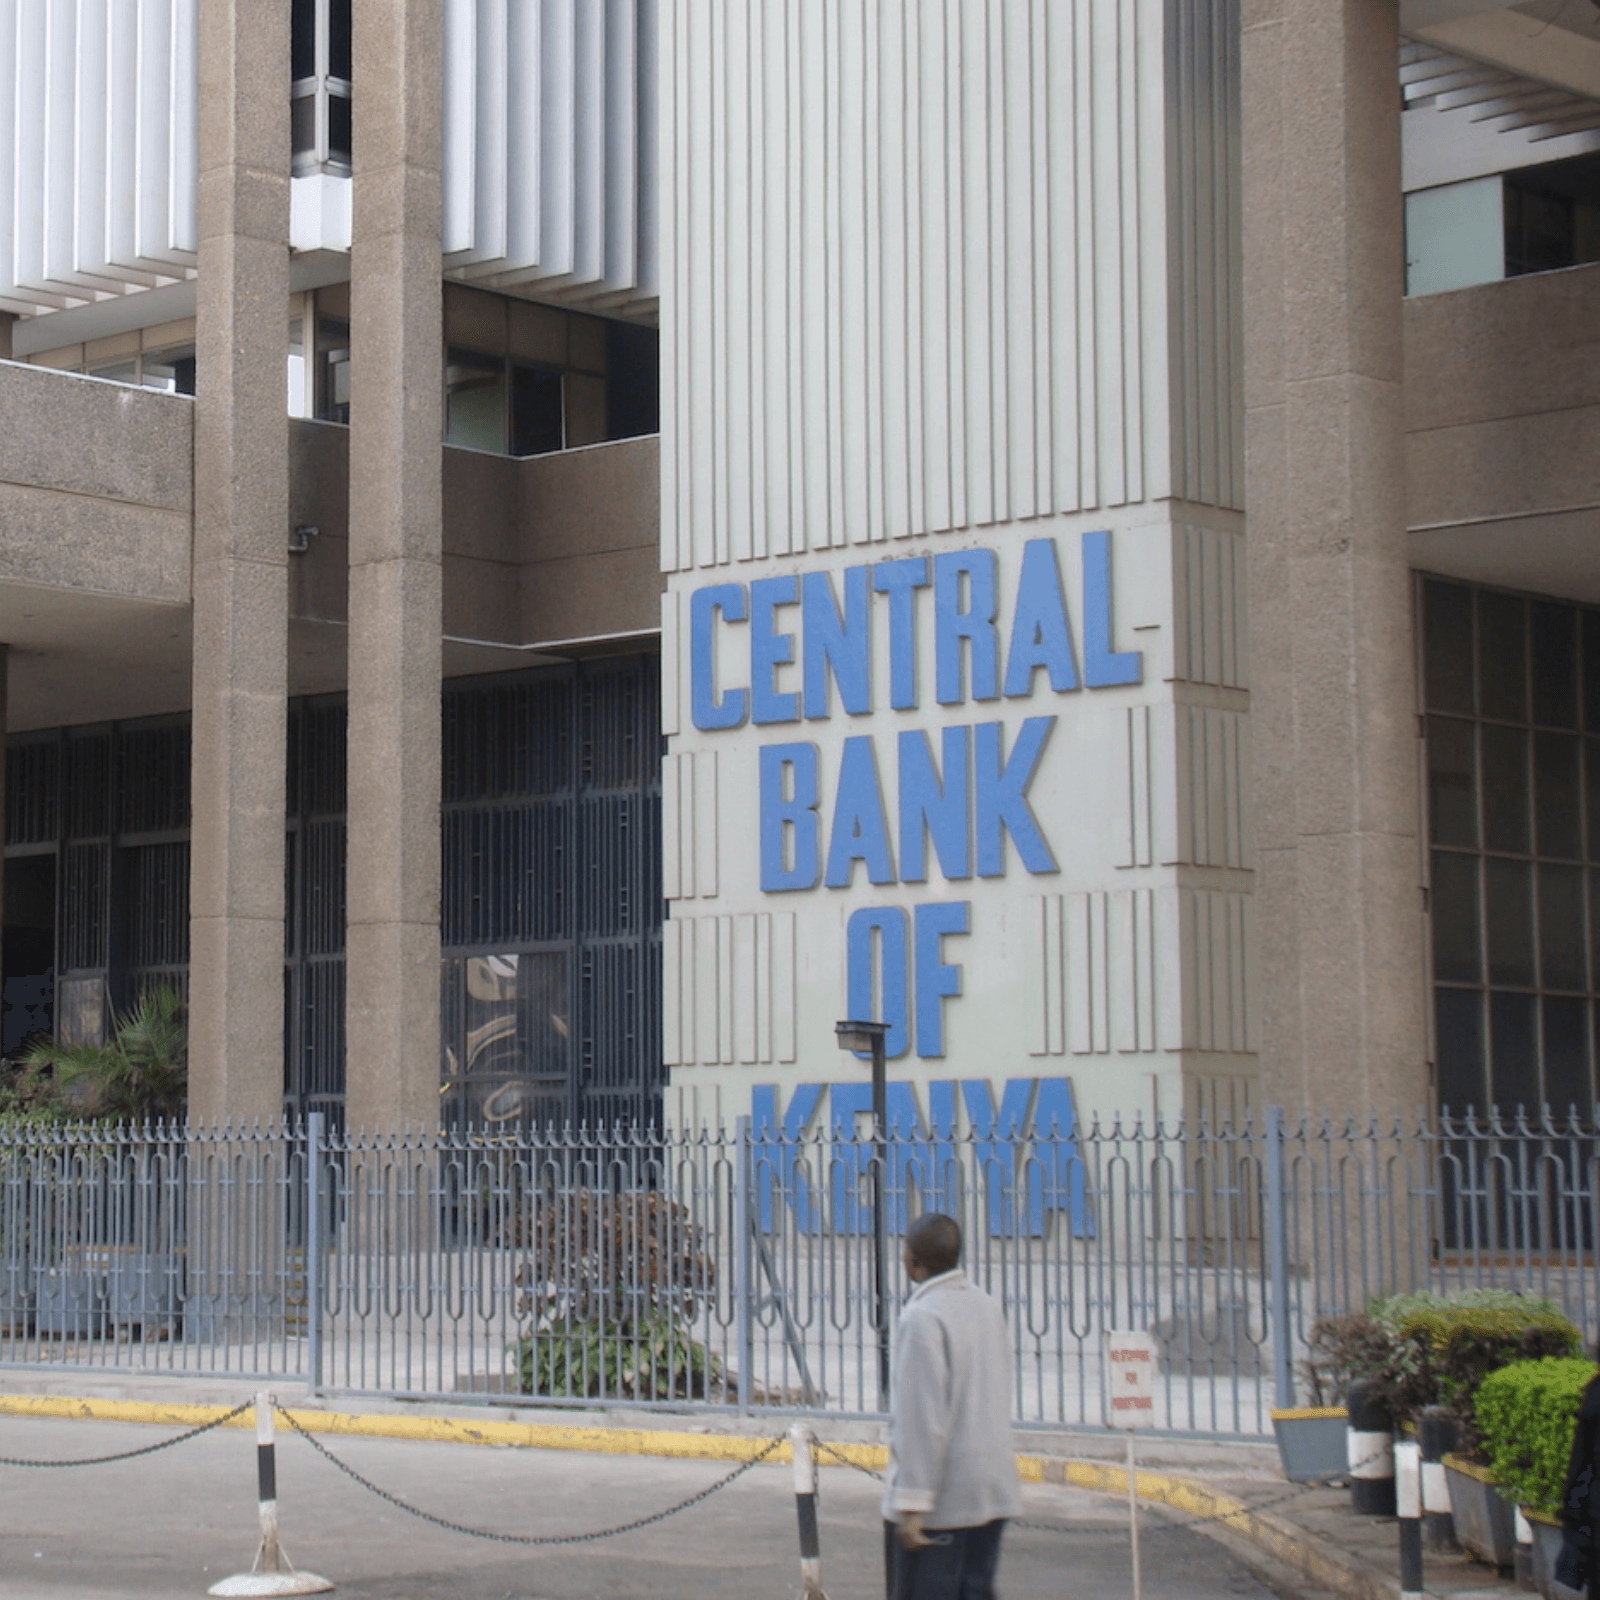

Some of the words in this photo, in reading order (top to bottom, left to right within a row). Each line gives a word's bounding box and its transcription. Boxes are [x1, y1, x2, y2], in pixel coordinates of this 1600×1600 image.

[691, 530, 1143, 731] CENTRAL
[759, 715, 1060, 893] BANK
[846, 901, 970, 1059] OF
[751, 1077, 1096, 1238] KENYA
